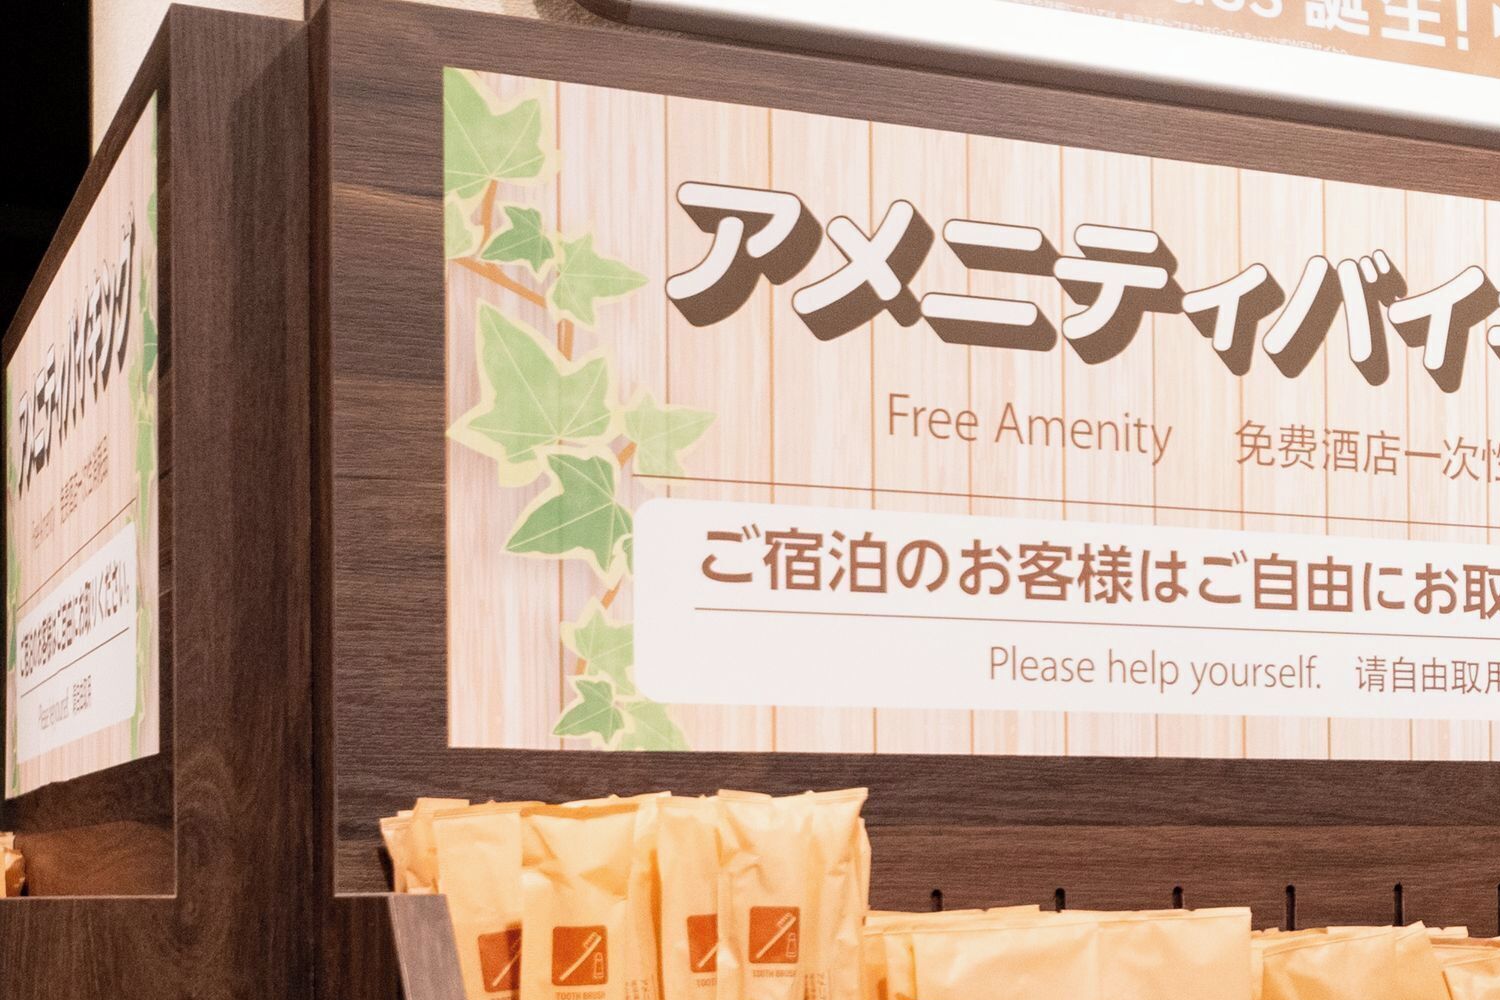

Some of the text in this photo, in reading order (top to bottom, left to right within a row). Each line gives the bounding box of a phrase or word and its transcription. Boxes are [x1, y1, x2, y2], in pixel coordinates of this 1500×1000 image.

[888, 393, 1174, 466] Free Amenity
[989, 646, 1321, 694] Please help yourself.
